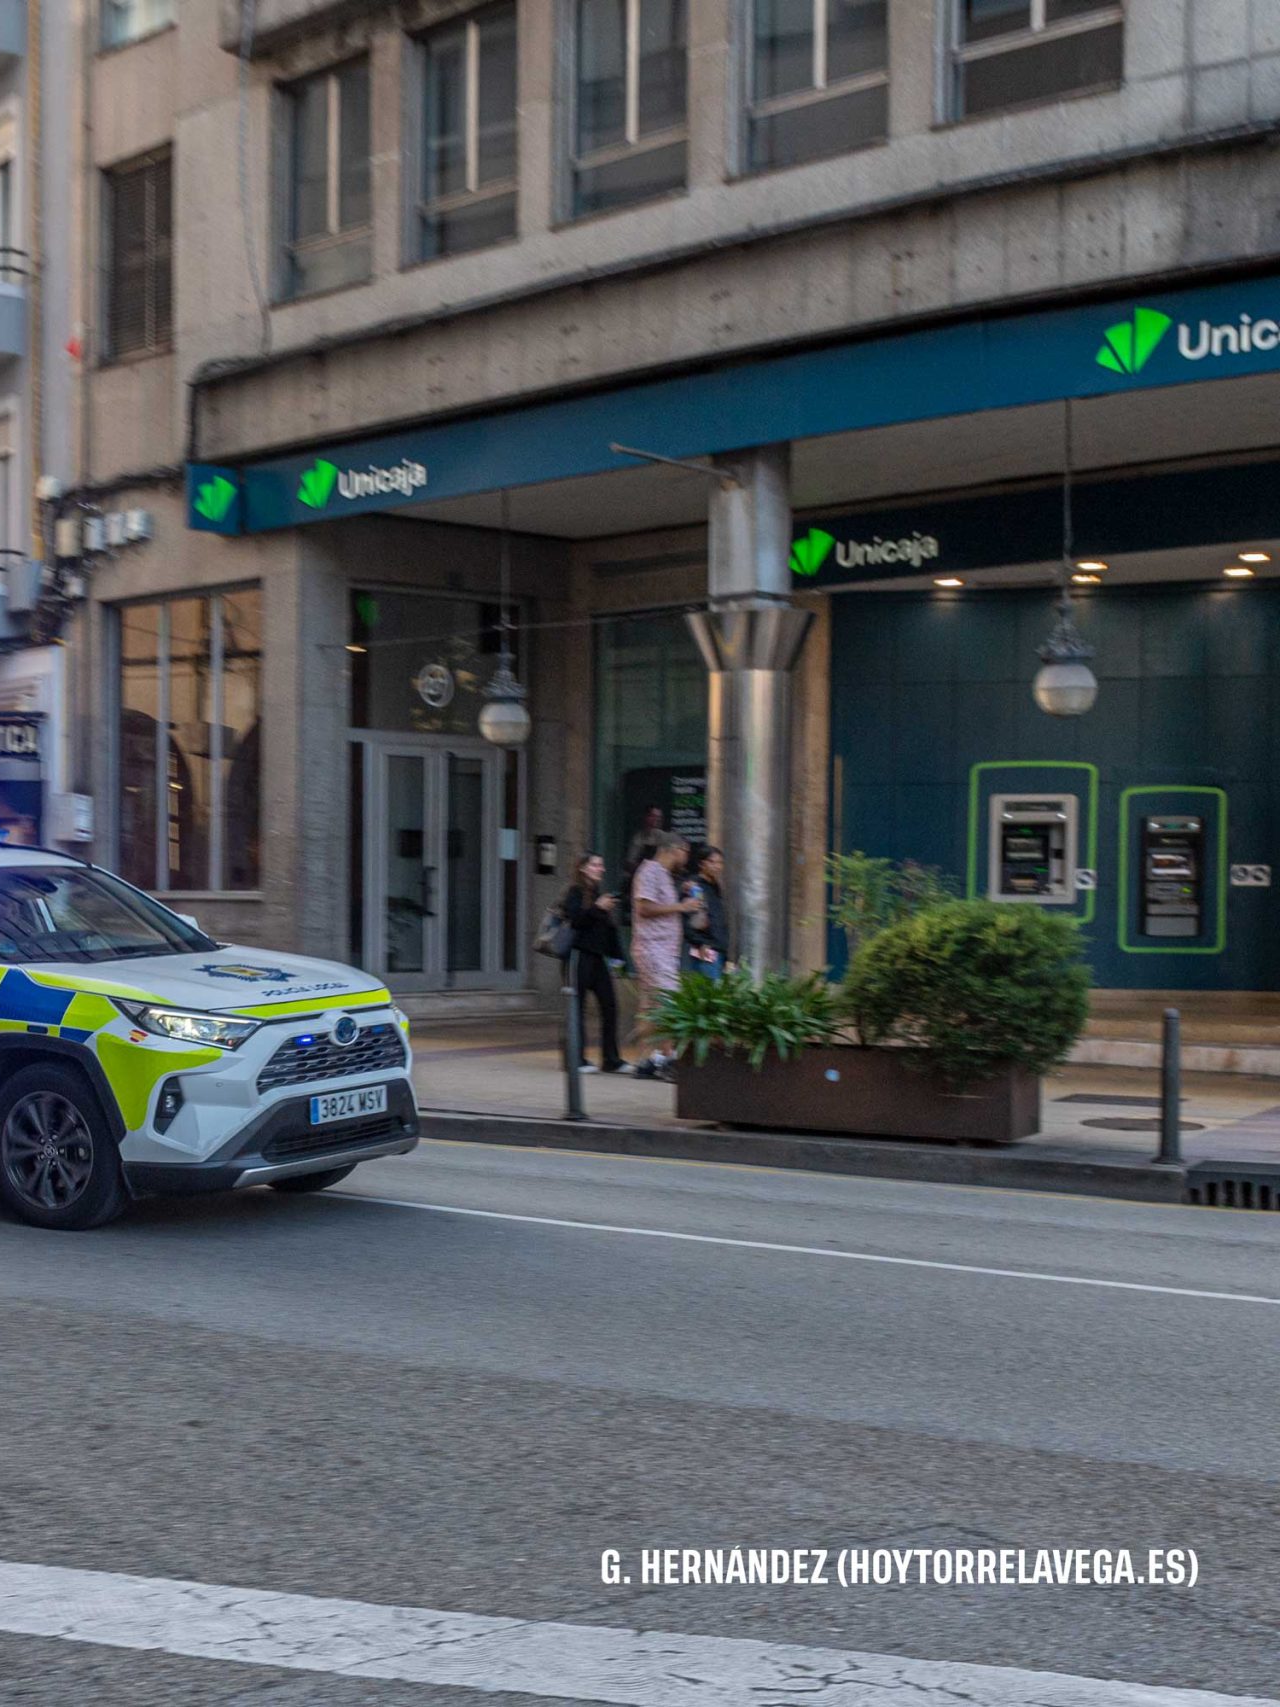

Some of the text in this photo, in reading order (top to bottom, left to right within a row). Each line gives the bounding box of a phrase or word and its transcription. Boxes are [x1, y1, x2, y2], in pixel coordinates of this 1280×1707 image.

[1177, 312, 1280, 361] Unic
[337, 457, 427, 500] Unicaja
[835, 530, 939, 568] Unicaja
[321, 1094, 354, 1118] 3824
